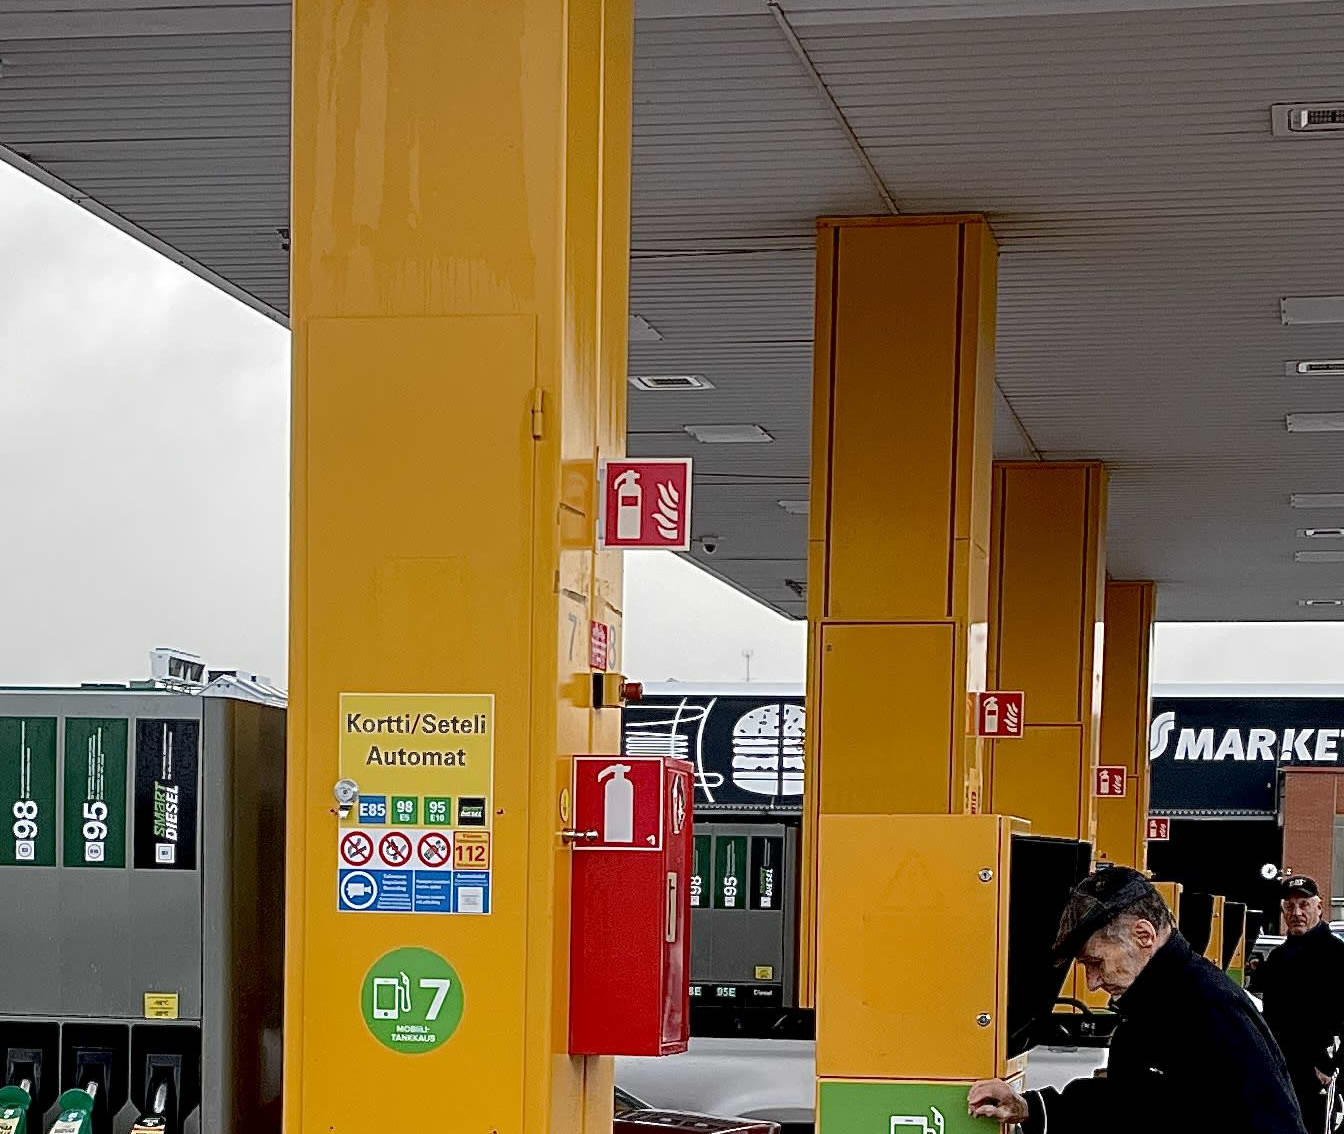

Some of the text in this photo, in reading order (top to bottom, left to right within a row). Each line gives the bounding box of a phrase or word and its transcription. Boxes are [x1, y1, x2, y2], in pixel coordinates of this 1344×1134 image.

[346, 713, 487, 737] Kortti/Seteli
[366, 745, 467, 767] Automat
[165, 785, 179, 842] DIESEL
[359, 802, 386, 817] E85
[396, 800, 414, 814] 98
[429, 801, 446, 815] 95
[13, 800, 38, 839] 98
[83, 801, 108, 840] 95
[455, 845, 486, 863] 112
[724, 876, 738, 896] 95
[419, 978, 451, 1021] 7
